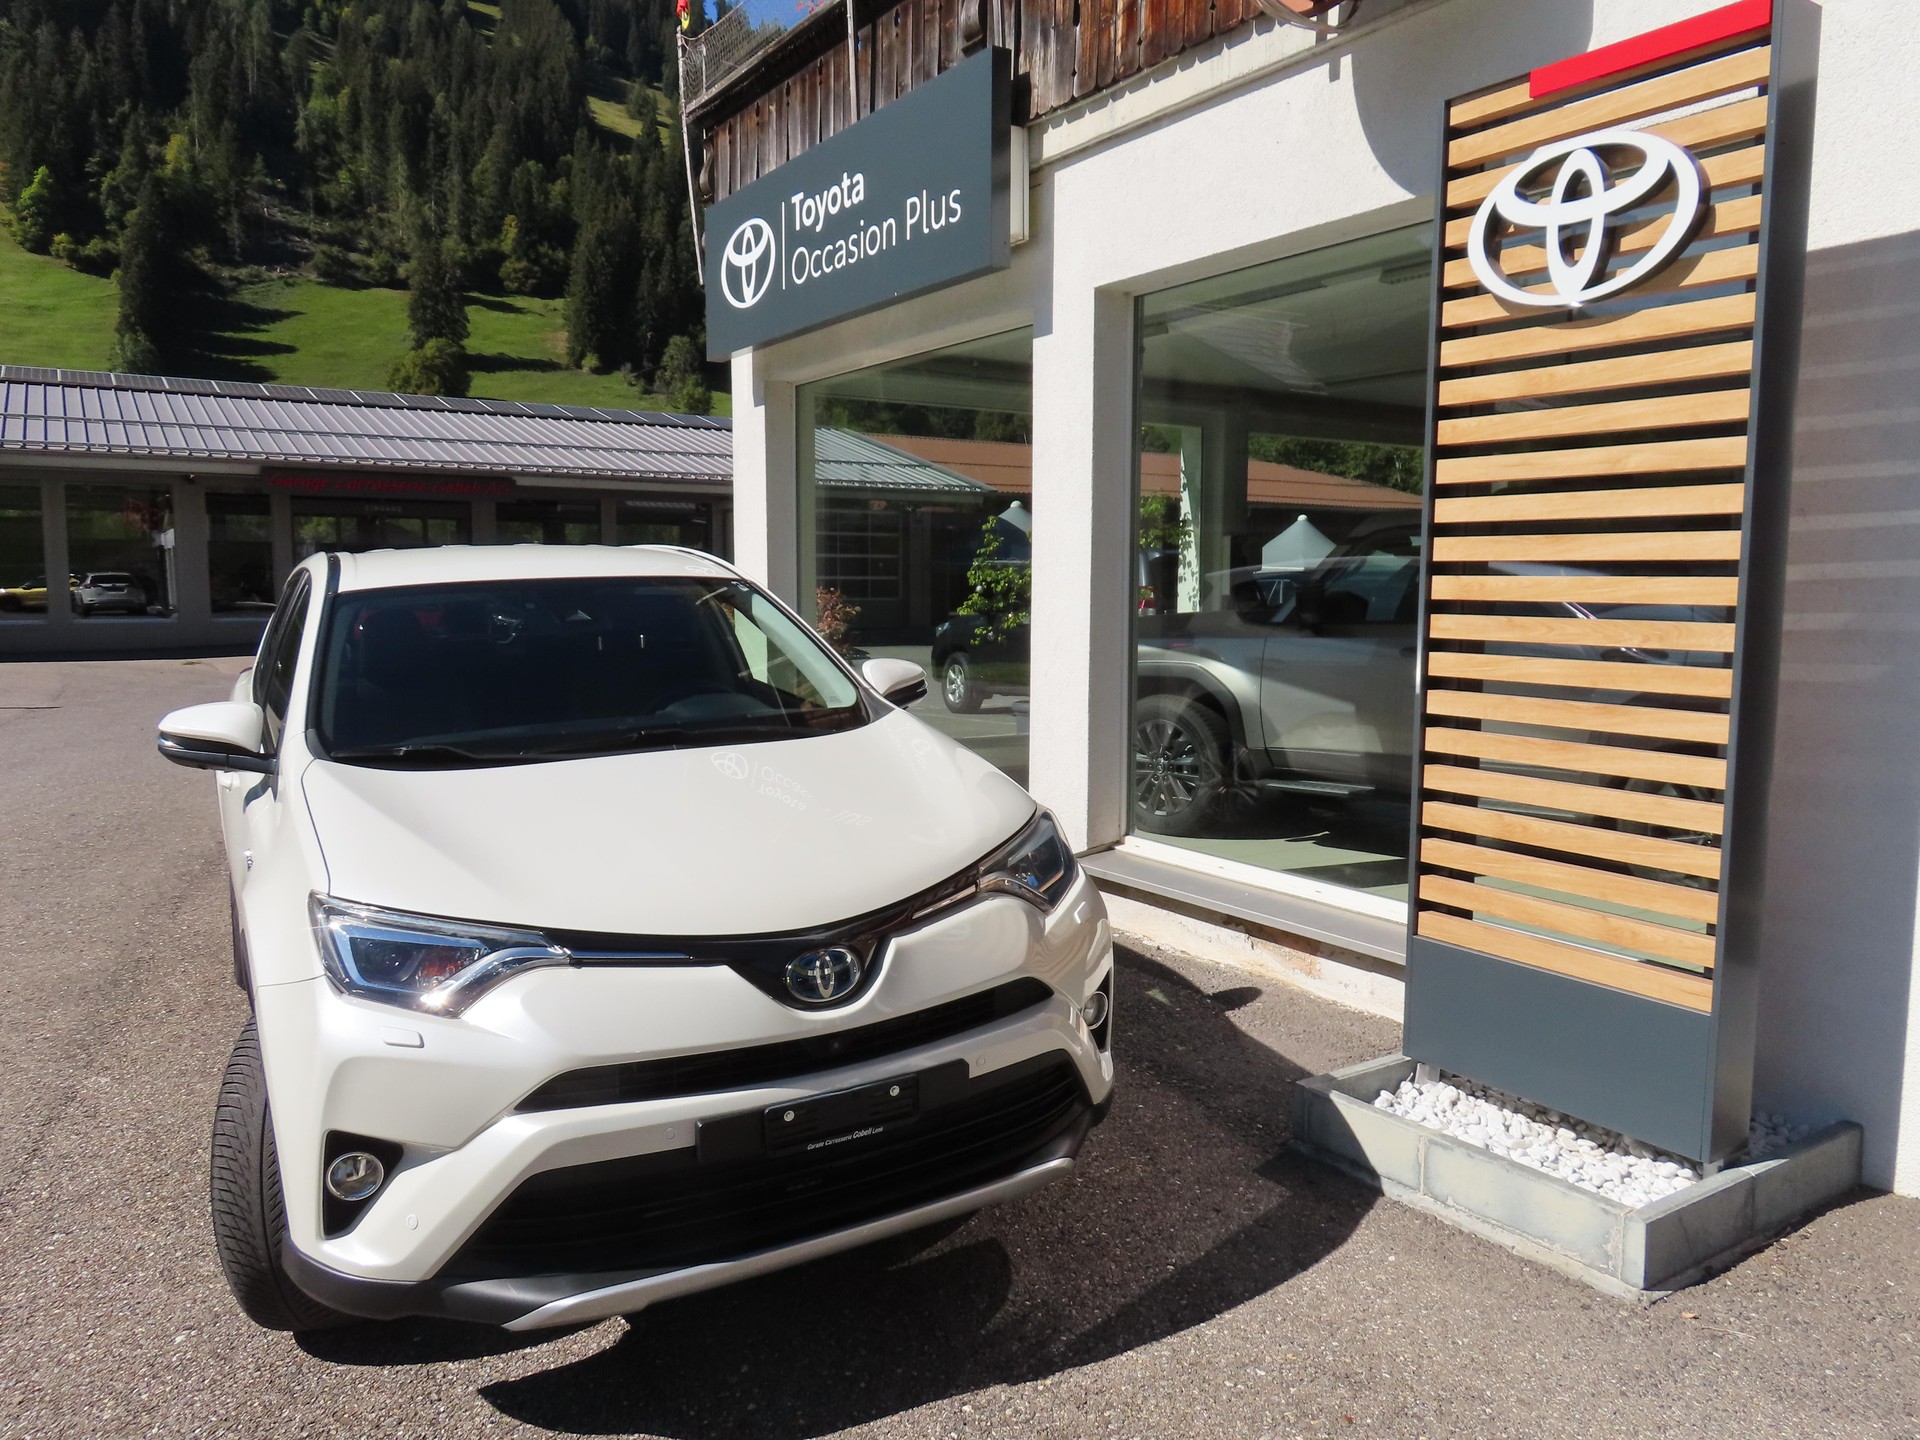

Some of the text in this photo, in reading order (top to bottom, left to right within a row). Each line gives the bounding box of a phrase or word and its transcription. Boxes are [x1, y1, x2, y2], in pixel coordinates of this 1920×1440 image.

[791, 171, 865, 233] Toyota
[791, 188, 962, 285] Occasion Plus
